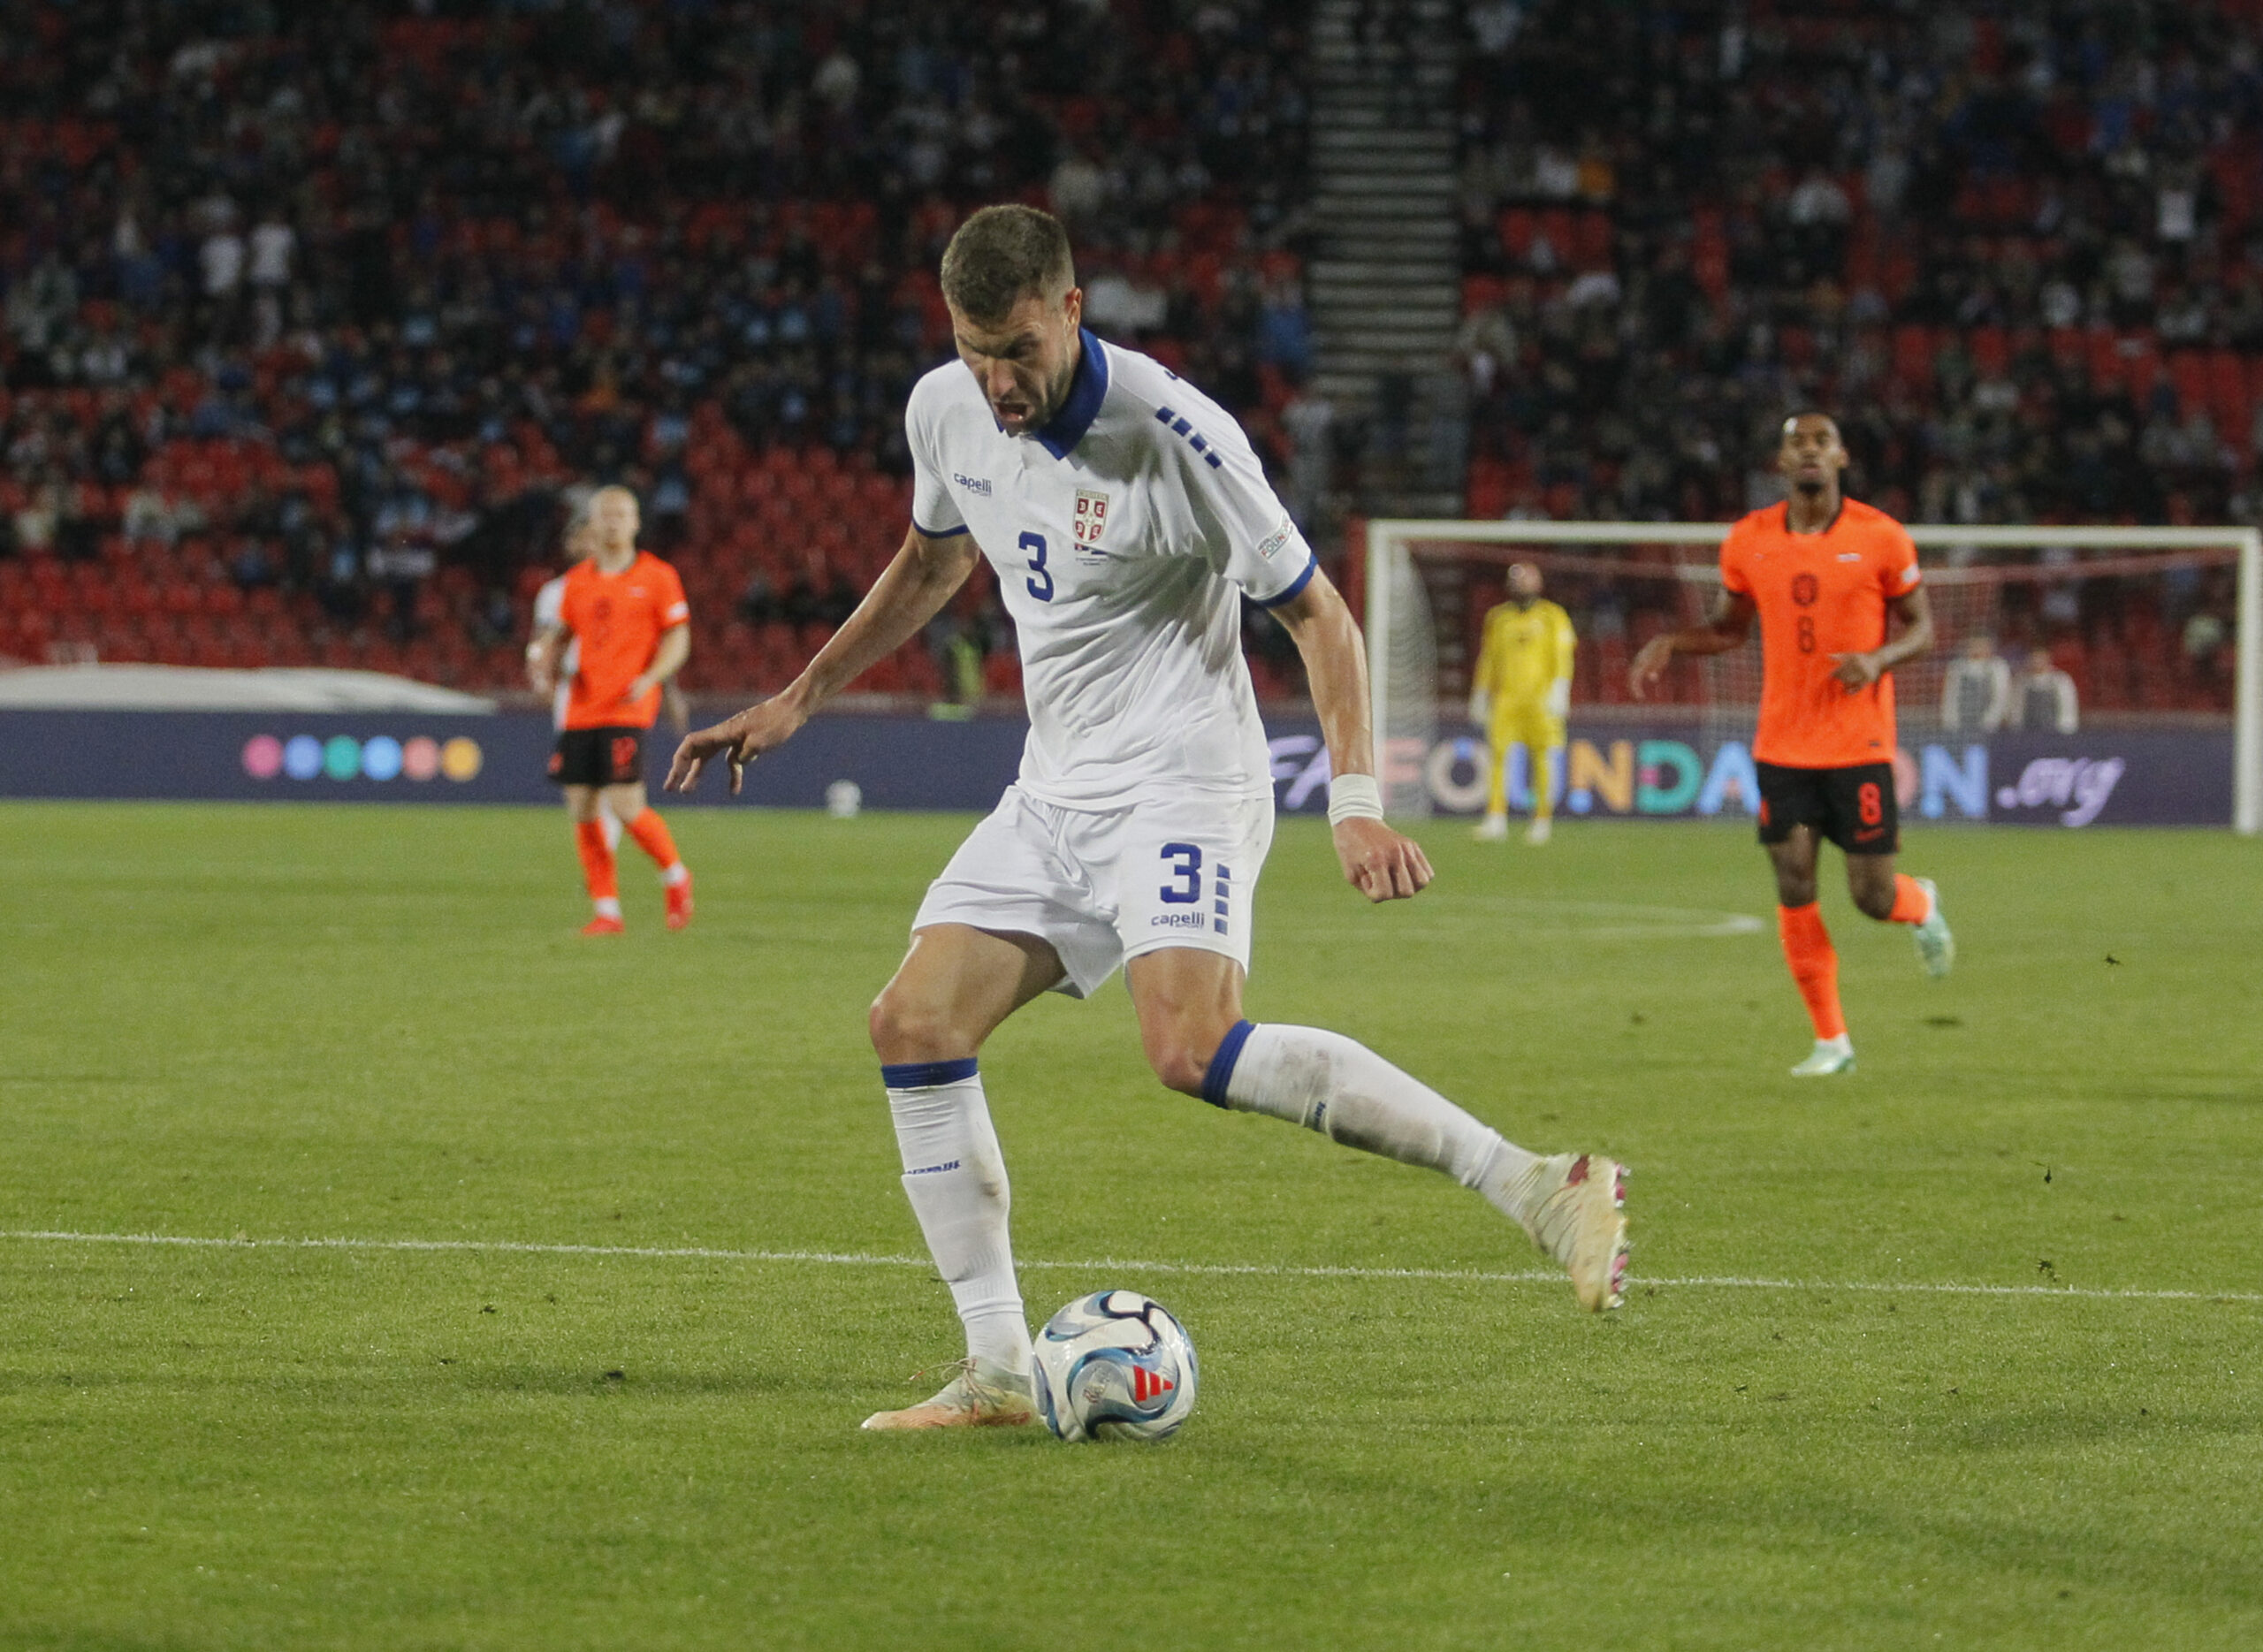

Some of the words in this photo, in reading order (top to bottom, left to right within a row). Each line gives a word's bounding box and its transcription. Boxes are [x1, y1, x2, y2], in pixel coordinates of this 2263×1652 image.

[954, 473, 992, 493] capelli
[1018, 530, 1055, 603] 3
[1858, 781, 1883, 826] 8
[1160, 841, 1202, 903] 3
[1150, 911, 1205, 927] capelli
